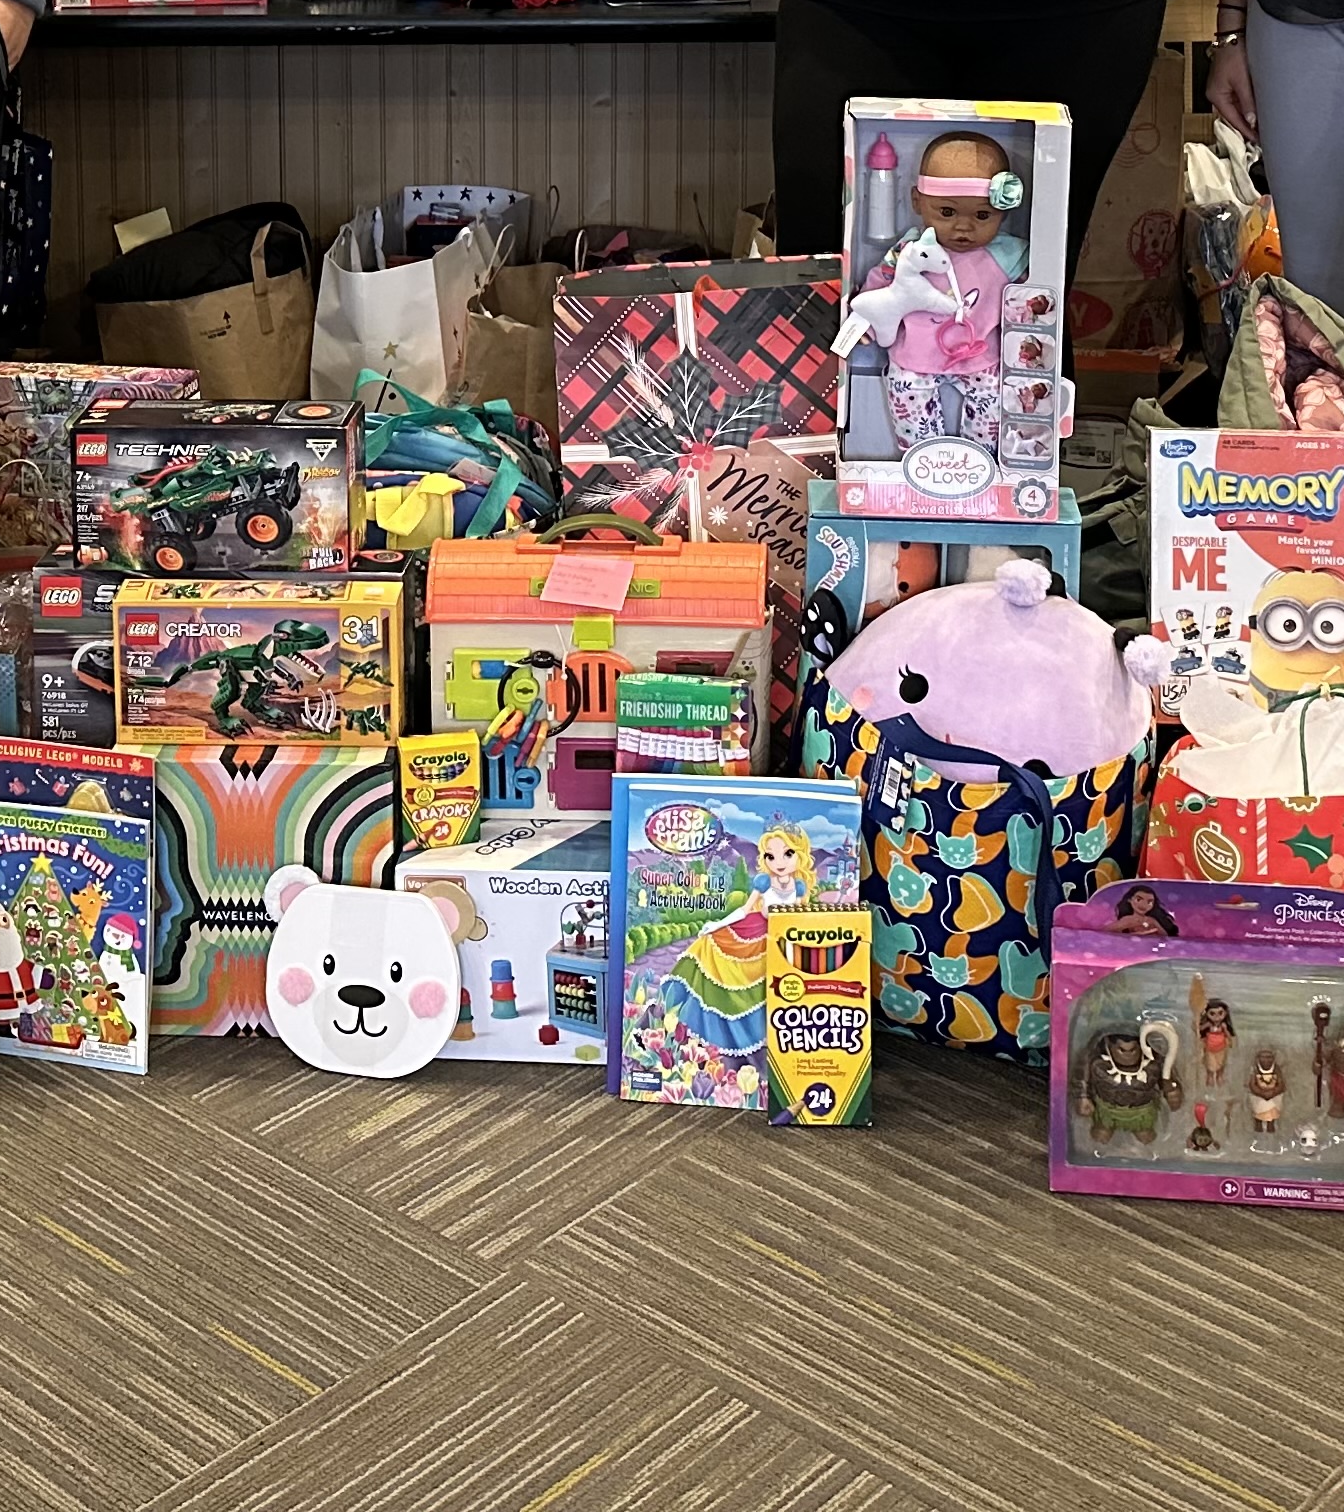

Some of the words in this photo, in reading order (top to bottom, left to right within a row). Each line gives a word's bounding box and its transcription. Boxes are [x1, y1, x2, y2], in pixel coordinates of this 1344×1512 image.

[77, 443, 107, 457] LEGO
[115, 444, 213, 456] TECHNIC
[1295, 441, 1318, 449] AGES
[939, 450, 955, 460] my
[916, 453, 986, 479] Sweet
[76, 471, 92, 483] 7+
[776, 479, 802, 500] THE
[1028, 490, 1036, 501] 4
[1227, 513, 1295, 525] GAME
[1172, 536, 1227, 547] DESPICABLE
[1278, 536, 1310, 544] Match
[1296, 546, 1331, 555] favorite
[1172, 548, 1227, 591] ME
[43, 589, 81, 605] LEGO
[126, 622, 157, 637] LEGO
[165, 623, 242, 637] CREATOR
[127, 655, 152, 668] 7-12
[42, 674, 65, 688] 9+
[128, 695, 144, 704] 174
[1162, 685, 1187, 700] USA
[620, 701, 683, 719] FRIENDSHIP
[685, 704, 727, 721] THREAD
[42, 717, 59, 727] 581
[46, 750, 72, 762] LEGO
[82, 754, 123, 768] MODELS
[413, 751, 467, 767] Crayola
[411, 803, 472, 822] CRAYONS
[19, 817, 55, 832] PUFFY
[56, 822, 107, 838] STICKERS!
[434, 824, 449, 838] 24
[72, 844, 114, 880] Fun!
[640, 868, 674, 886] Super
[489, 877, 562, 895] Wooden
[567, 876, 611, 897] Acti
[650, 894, 695, 912] Activity
[697, 894, 726, 911] Book
[1293, 892, 1334, 910] Disney
[786, 927, 854, 943] Crayola
[773, 1006, 866, 1030] COLORED
[779, 1027, 861, 1053] PENCILS
[808, 1088, 832, 1109] 24
[1225, 1183, 1237, 1193] 3+
[1263, 1187, 1311, 1199] WARNING:
